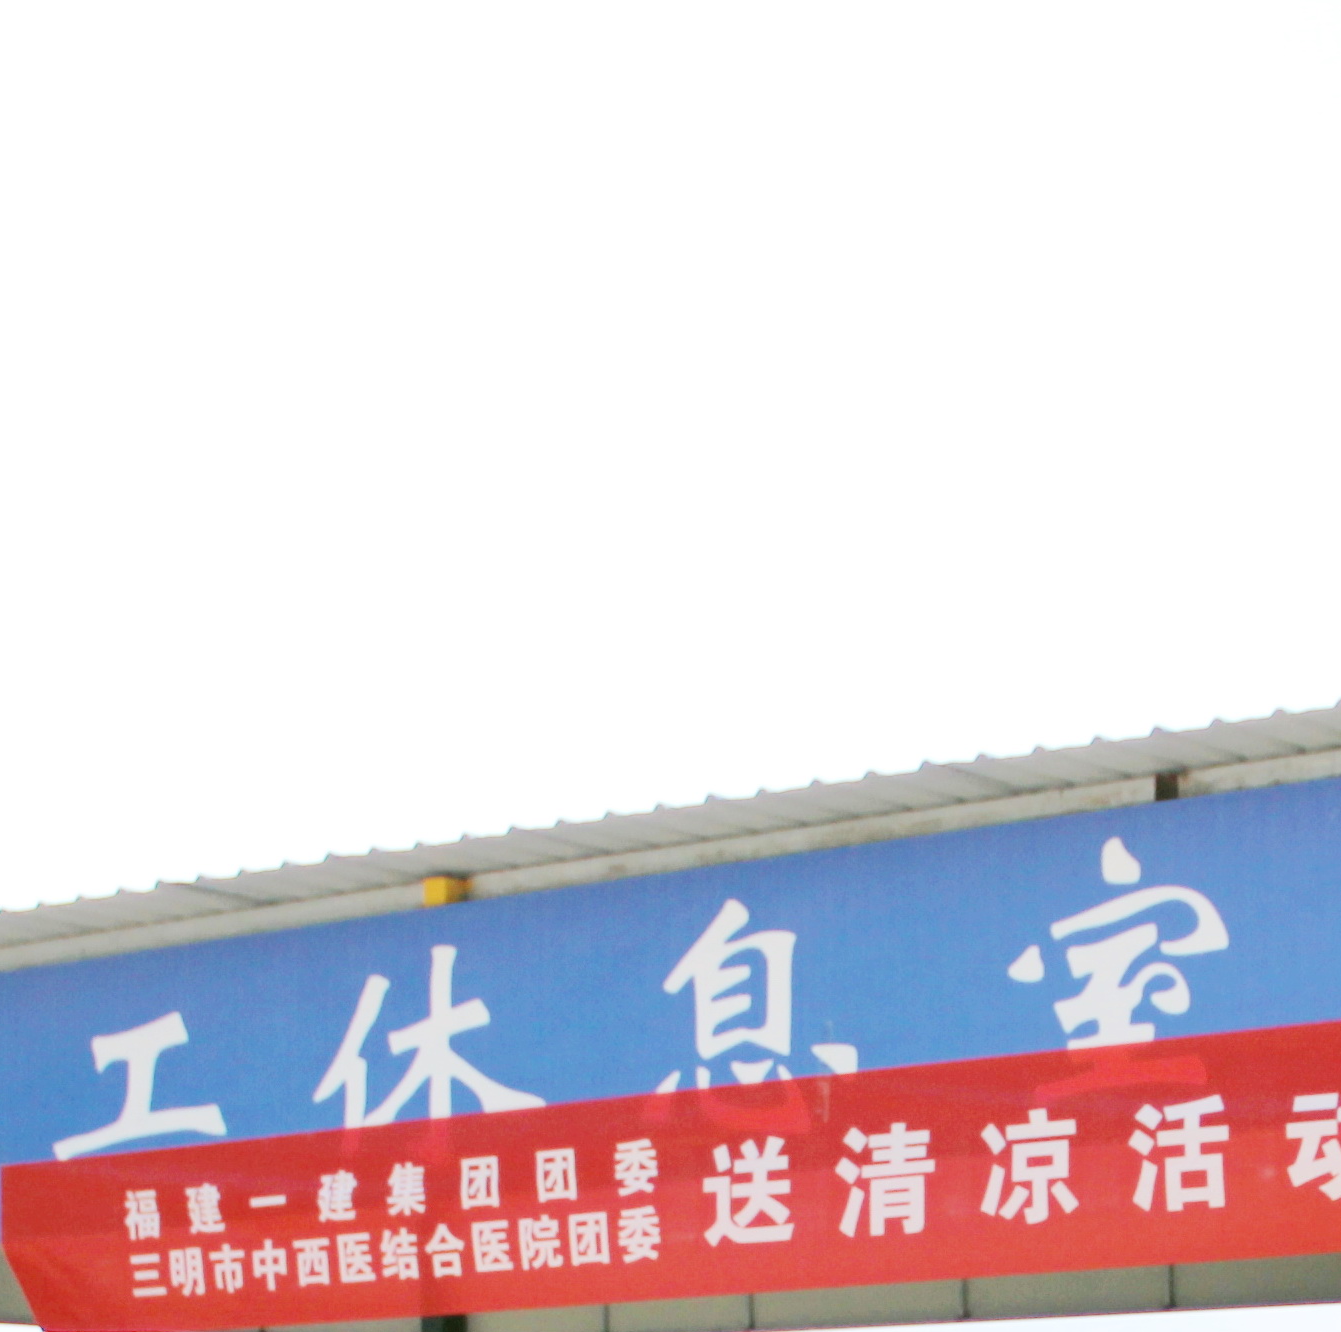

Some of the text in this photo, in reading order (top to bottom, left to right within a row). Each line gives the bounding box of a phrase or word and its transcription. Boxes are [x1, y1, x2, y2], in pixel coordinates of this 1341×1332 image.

[124, 1138, 659, 1241] 福建一建集团团委
[131, 1204, 662, 1299] 三明市中西医结合医院团委
